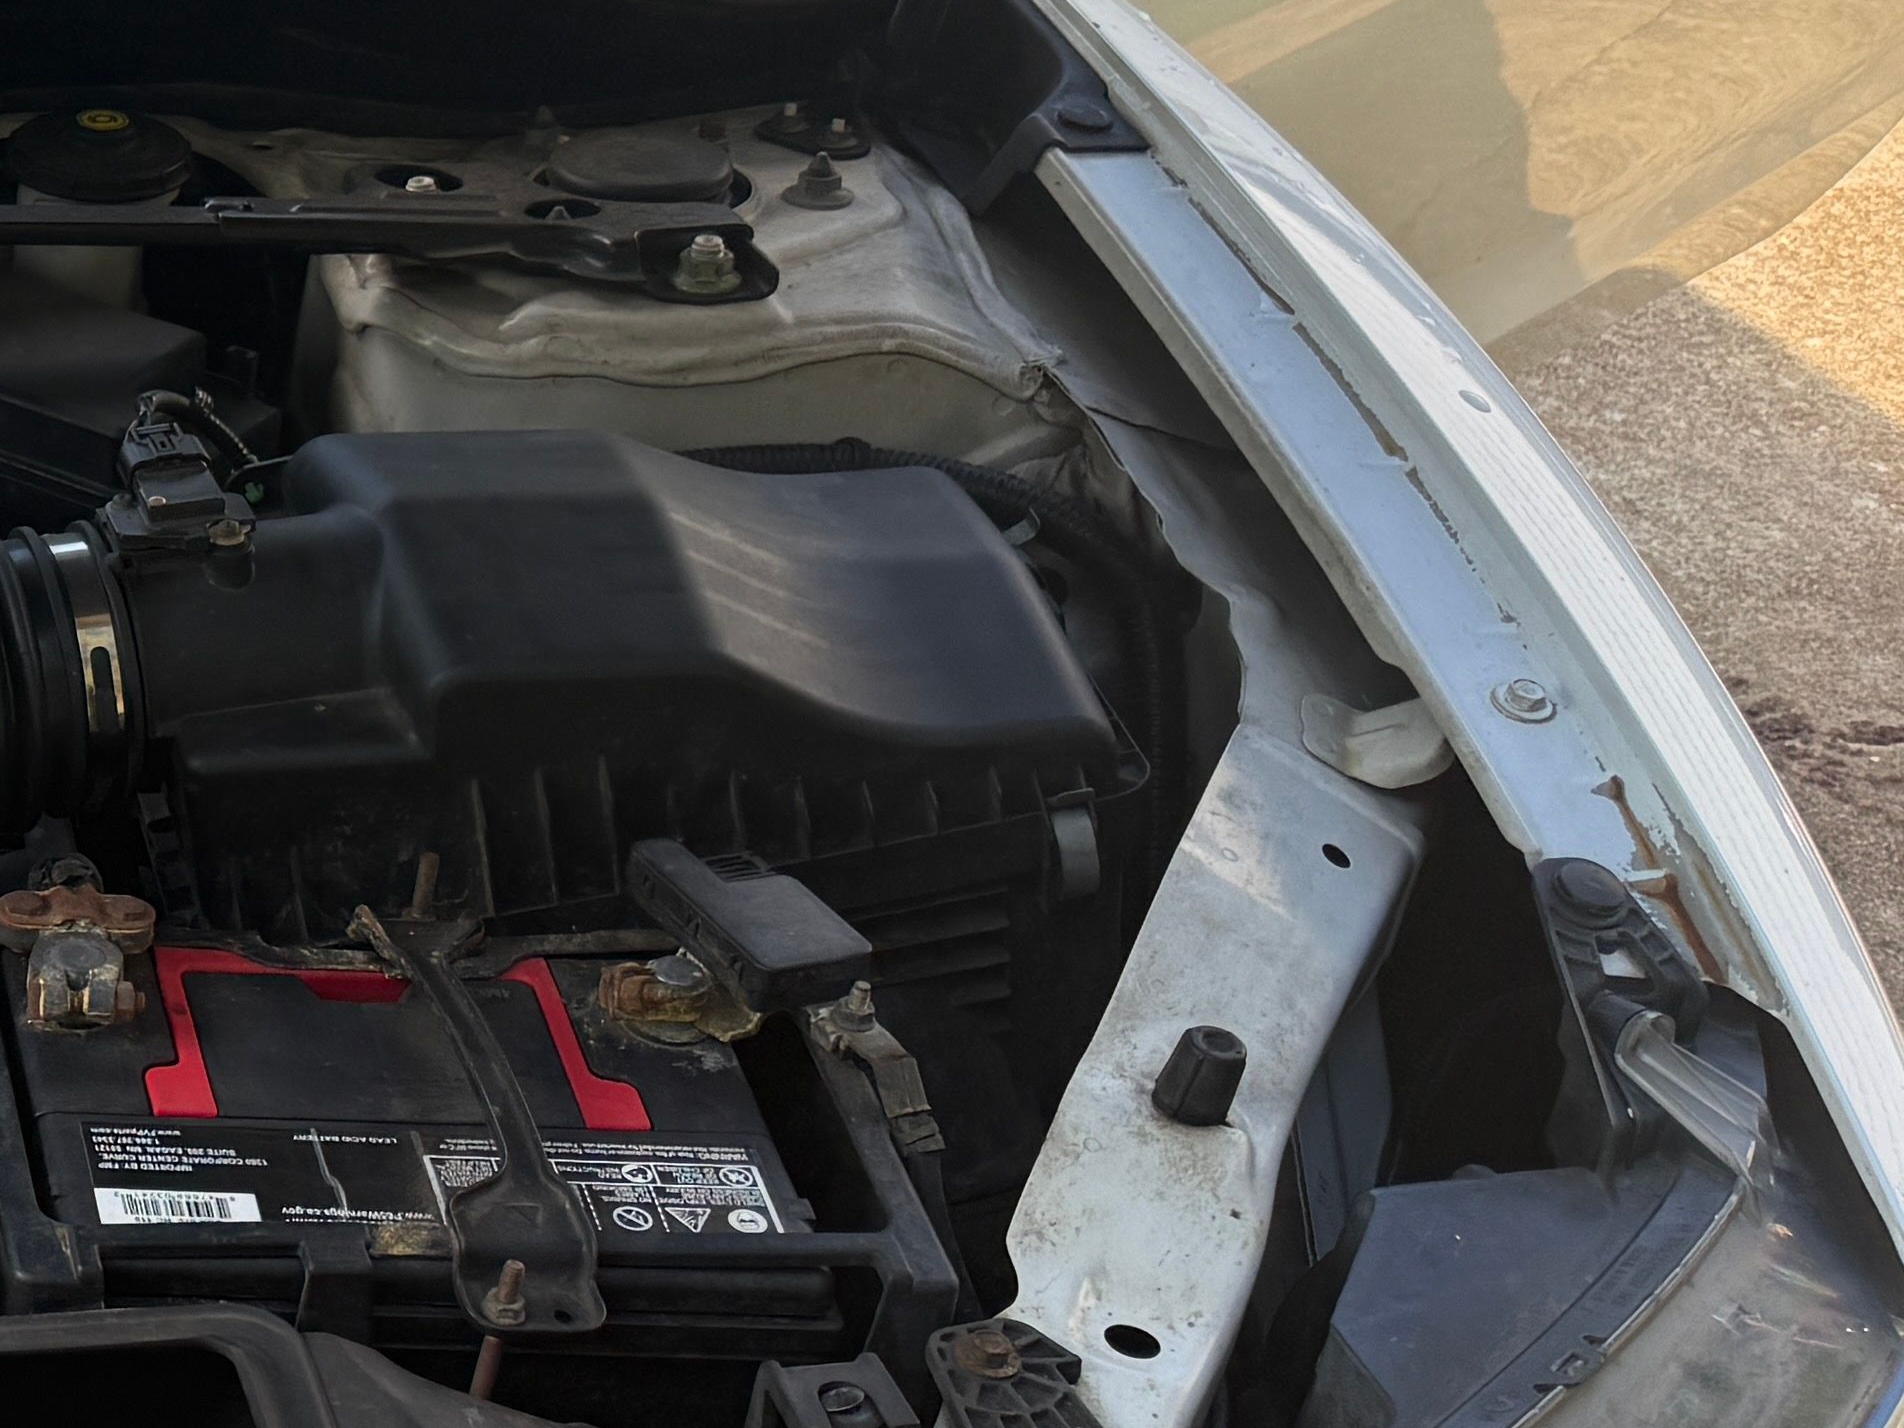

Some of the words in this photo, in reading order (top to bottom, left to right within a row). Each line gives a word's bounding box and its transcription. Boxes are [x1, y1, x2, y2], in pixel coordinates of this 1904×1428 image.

[293, 1134, 339, 1142] BATTERY
[341, 1135, 367, 1143] ACID
[369, 1136, 397, 1144] LEAD
[207, 1148, 235, 1156] SUITE
[137, 1154, 179, 1163] CENTER
[180, 1156, 243, 1165] CORPORATE
[140, 1162, 192, 1172] IMPORTED
